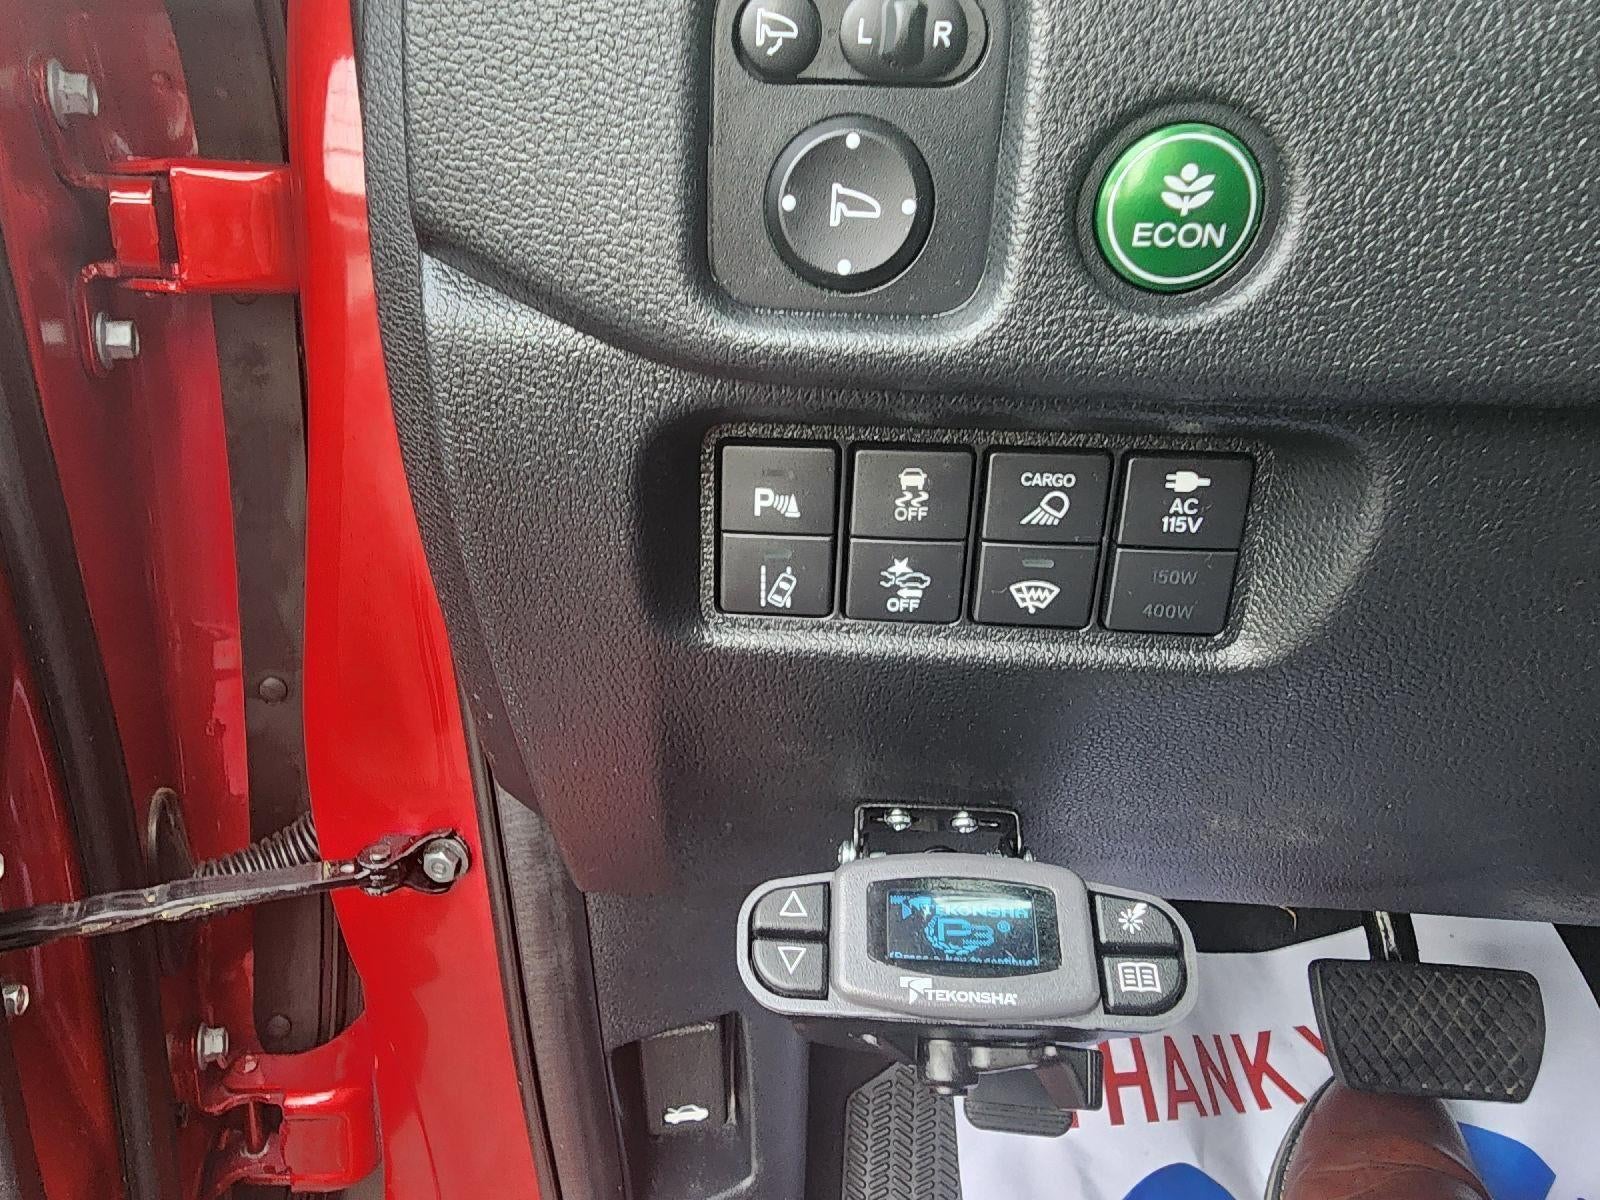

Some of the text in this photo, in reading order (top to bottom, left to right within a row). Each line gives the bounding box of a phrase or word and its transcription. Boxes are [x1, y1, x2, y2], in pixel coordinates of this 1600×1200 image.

[858, 18, 873, 45] L
[933, 20, 952, 48] R
[1131, 221, 1228, 249] ECON
[1020, 471, 1077, 487] CARGO
[894, 506, 929, 522] OFF
[1168, 497, 1200, 515] AC
[1161, 515, 1204, 533] 115V
[1152, 569, 1199, 585] 150W
[886, 597, 920, 613] OFF
[1142, 603, 1195, 619] 400W
[924, 989, 1018, 1007] TEKONSHA
[1070, 1029, 1308, 1129] HANK
